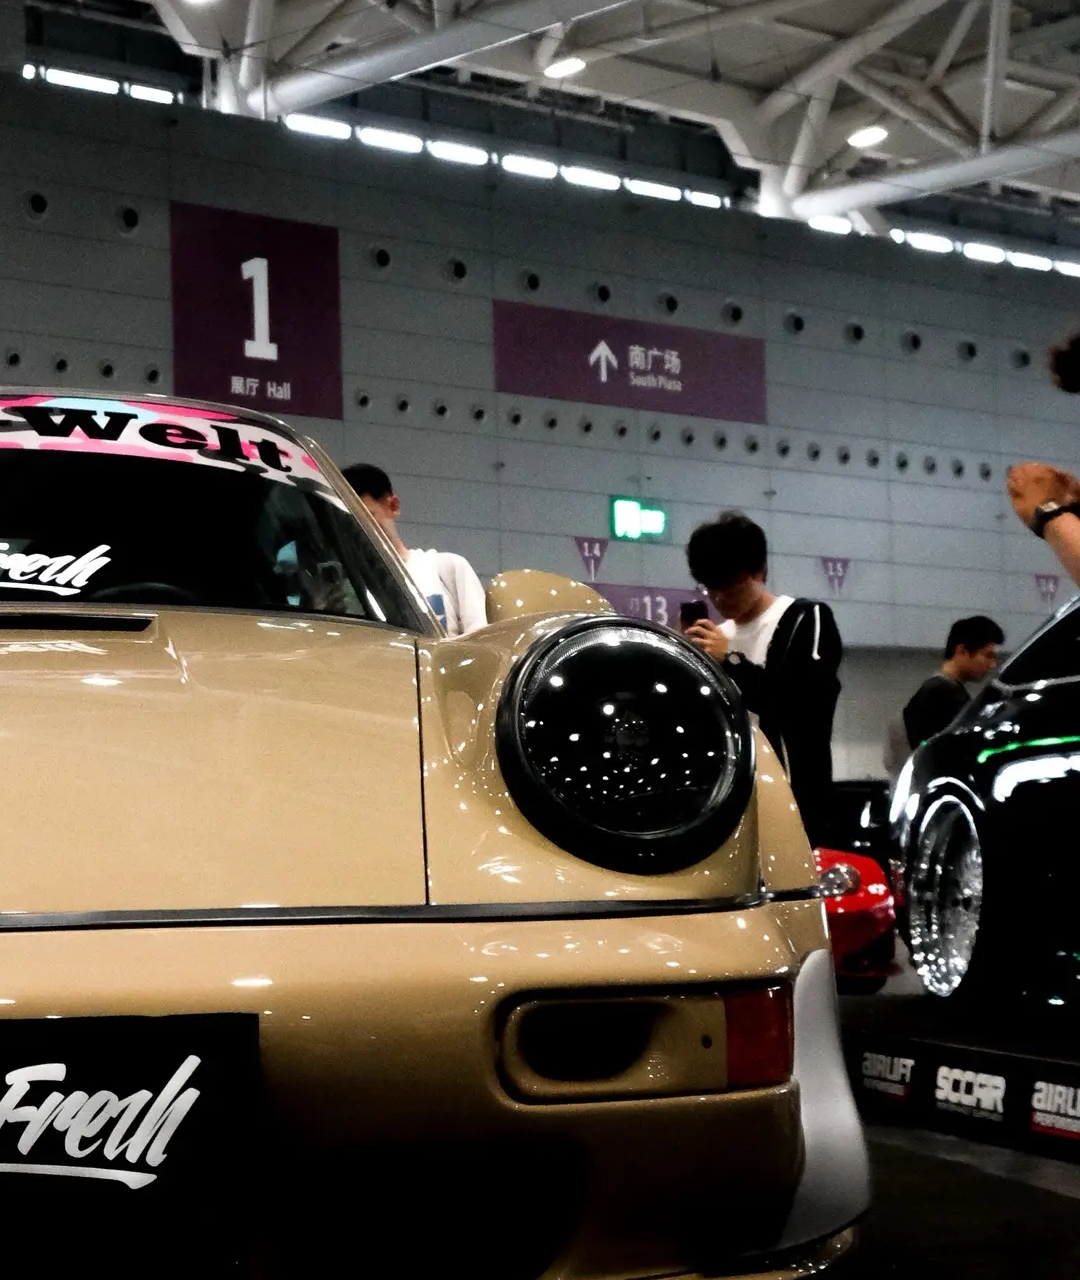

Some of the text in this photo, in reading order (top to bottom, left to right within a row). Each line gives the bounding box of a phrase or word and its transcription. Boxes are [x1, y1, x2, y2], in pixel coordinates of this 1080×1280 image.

[241, 257, 278, 361] 1
[628, 345, 681, 374] 南广场
[231, 375, 292, 401] 展厅 Hall
